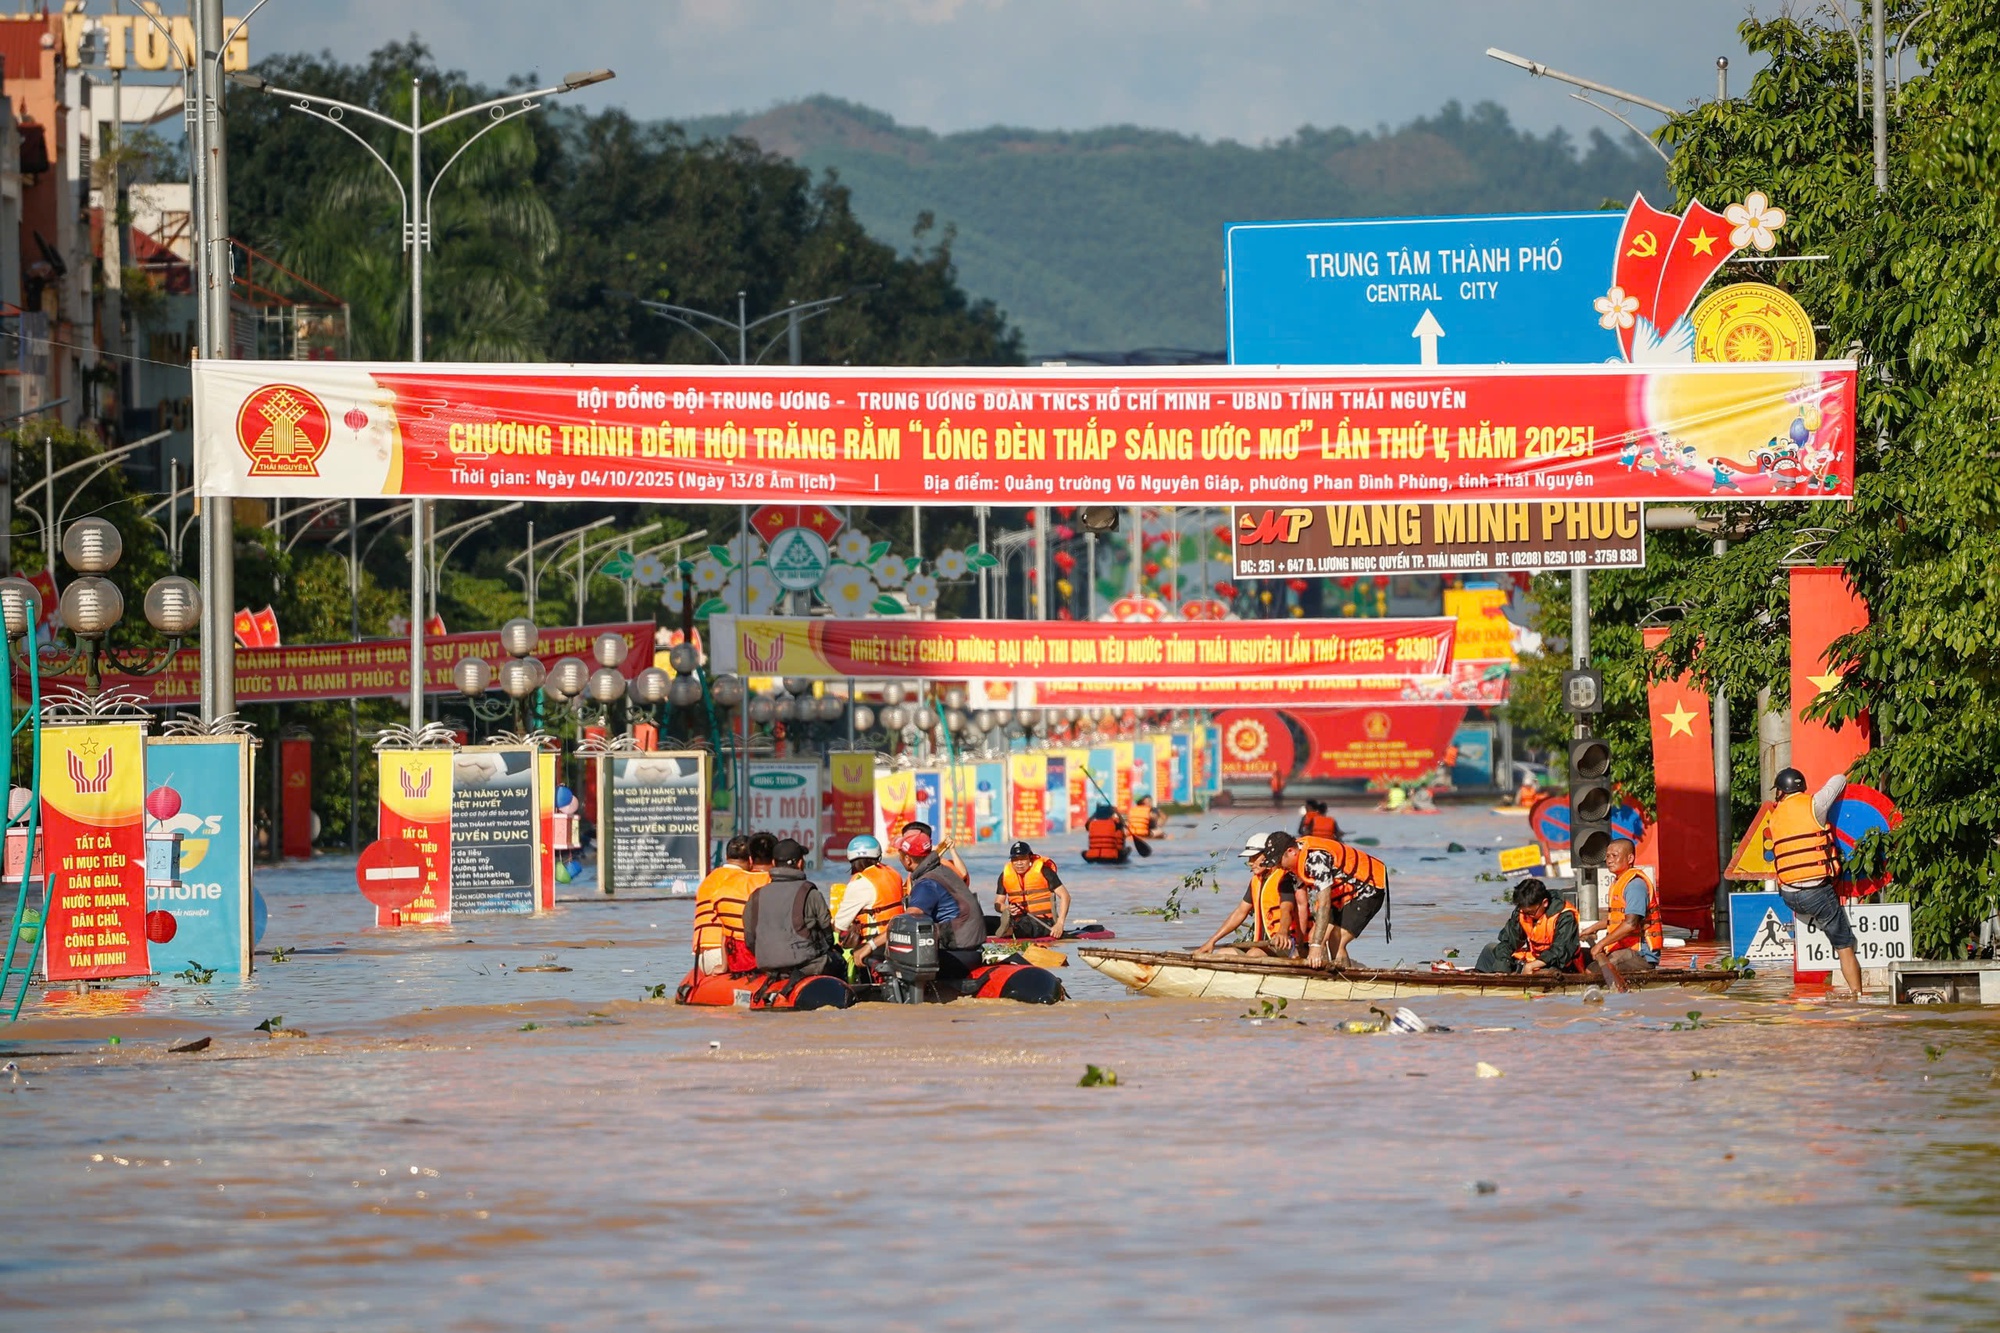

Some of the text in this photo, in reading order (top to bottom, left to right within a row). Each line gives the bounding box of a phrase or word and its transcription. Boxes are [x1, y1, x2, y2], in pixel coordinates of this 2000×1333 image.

[1306, 238, 1563, 278] TRUNG TÂM THÀNH PHỐ
[1366, 281, 1499, 303] CENTRAL CITY
[577, 384, 1467, 415] HỘI ĐỒNG ĐỘI TRUNG ƯƠNG TRUNG ƯƠNG ĐOÀN TNCS HỒ CHÍ MINH UBND TỈNH THÁI NGUYÊN
[449, 421, 553, 455] CHƯƠNG
[559, 420, 634, 457] TRÌNH
[640, 420, 697, 459] ĐÊM
[704, 420, 748, 466] HỘI
[753, 421, 836, 460] TRĂNG
[844, 416, 901, 461] RẰM
[995, 418, 1046, 461] ĐÈN
[1053, 416, 1117, 461] THẮP
[1125, 421, 1193, 461] SÁNG
[1200, 421, 1251, 461] ƯỚC
[1321, 416, 1370, 460] LẦN
[1377, 420, 1427, 460] THỨ
[1433, 426, 1451, 463] V,
[1458, 420, 1517, 459] NĂM
[1525, 426, 1595, 458] 2025!
[258, 461, 309, 472] THÁI NGUYÊN
[449, 468, 836, 493] Thời gian: Ngày 04/10/2025 (Ngày 13/8 Âm lịch)
[924, 471, 1594, 494] Địa điểm: Quảng trường Võ Nguyên Giáp, phường Phan Đình Phùng, tỉnh Thái Nguyên
[1433, 502, 1530, 545] MINH
[1240, 548, 1638, 573] ĐC: 251 647 Đ. LƯƠNG NGỌC QUYẾN TP. THÁI NGUYÊN ĐT: (0208) 6250 108 3759 838
[237, 648, 281, 670] GÀNH
[285, 647, 342, 669] NGÀNH
[348, 646, 372, 664] THI
[375, 644, 406, 663] ĐUA
[458, 638, 499, 661] PHÁT
[850, 631, 1438, 669] NHIỆT LIỆT CHÀO MỪNG ĐẠI HỘI THI ĐUA YÊU NƯỚC TỈNH THÁI NGUYÊN LẦN THỨ I (2025 2030)!
[276, 672, 298, 692] VÀ
[302, 672, 347, 694] HẠNH
[352, 666, 394, 688] PHÚC
[457, 787, 528, 798] TÀI NĂNG VÀ SỰ
[472, 798, 502, 808] HUYẾT
[75, 831, 112, 850] TẤT CẢ
[402, 826, 428, 839] TẤT CẢ
[493, 830, 529, 842] DỤNG
[421, 841, 438, 853] TIÊU
[62, 852, 126, 871] VÌ MỤC TIÊU
[68, 872, 122, 889] DÂN GIÀU,
[62, 892, 130, 910] NƯỚC MẠNH,
[71, 909, 122, 928] DÂN CHỦ,
[64, 928, 130, 948] CÔNG BẰNG,
[69, 950, 127, 967] VĂN MINH!
